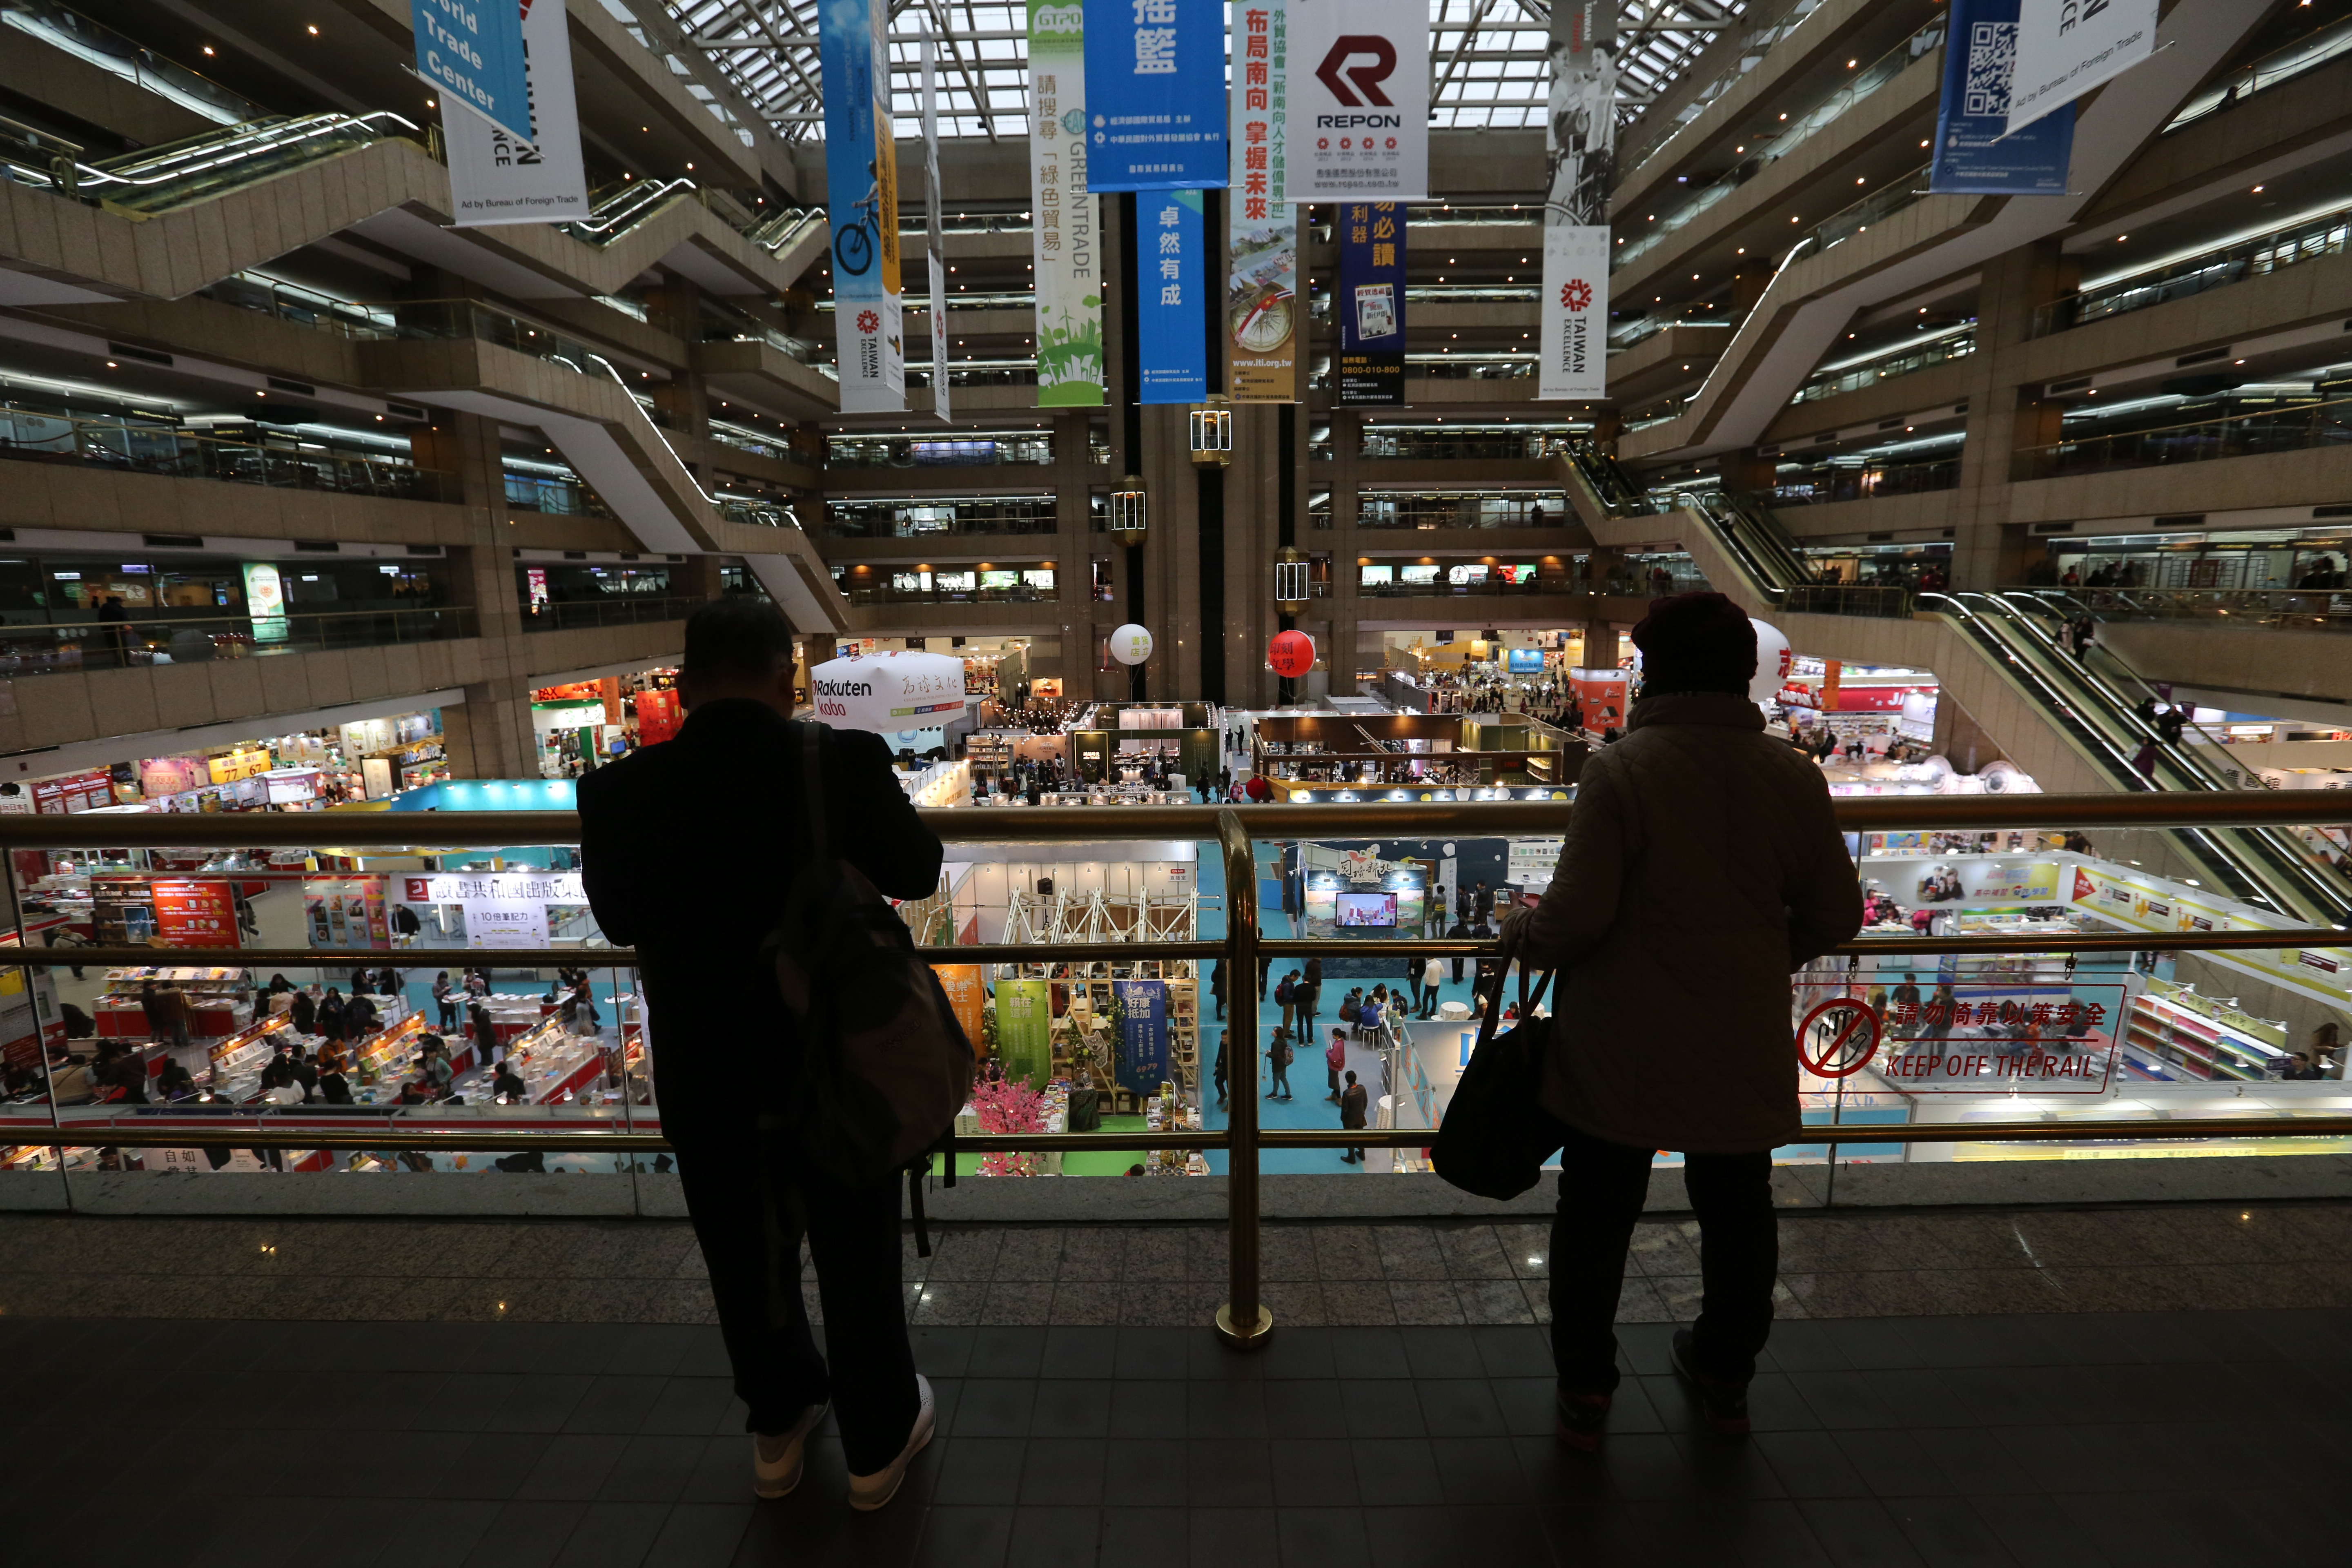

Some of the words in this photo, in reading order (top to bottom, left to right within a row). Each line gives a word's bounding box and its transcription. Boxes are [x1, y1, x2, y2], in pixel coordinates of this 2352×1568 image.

[430, 0, 478, 35] orld
[1584, 2, 1592, 41] TAIWAN
[422, 9, 483, 70] Trade
[1245, 8, 1268, 111] 布局南向
[2015, 96, 2027, 109] Ad
[2028, 90, 2038, 102] by
[2038, 74, 2069, 94] Bureau
[2070, 67, 2079, 78] of
[2080, 47, 2114, 71] Foreign
[2116, 29, 2143, 51] Trade
[427, 50, 495, 111] Center
[1317, 114, 1401, 129] REPON
[1037, 75, 1061, 262] 請搜尋「綠色貿易」
[1245, 120, 1267, 220] 掌握未來
[461, 200, 473, 209] Ad
[474, 199, 484, 210] by
[486, 198, 514, 207] Bureau
[526, 196, 555, 206] Foreign
[1351, 205, 1368, 243] 利器
[1159, 205, 1181, 305] 卓然有成
[1562, 318, 1572, 373] EXCELLENCE
[1573, 316, 1586, 373] TAIWAN
[868, 336, 879, 379] TAIWAN
[1232, 359, 1292, 369] www.iti.org.tw
[1342, 366, 1400, 374] 0800-010-800
[1131, 636, 1140, 657] 書店
[1270, 641, 1294, 655] 印刻
[1270, 658, 1295, 670] 文學
[817, 679, 872, 696] Rakuten
[902, 674, 958, 695] 高談文化
[817, 698, 846, 716] kobo
[223, 768, 237, 782] 77
[248, 763, 261, 775] 67
[945, 981, 968, 992] 愛樂
[948, 992, 969, 1003] 人士
[1009, 997, 1032, 1008] 賴在
[1127, 998, 1151, 1009] 好康
[1010, 1009, 1033, 1019] 這裡
[1127, 1008, 1151, 1019] 抵加
[1895, 1001, 2107, 1027] 請勿倚靠以策安全
[1147, 1062, 1158, 1071] 79
[1885, 1055, 1942, 1077] KEEP
[1946, 1055, 1989, 1077] OFF
[1995, 1055, 2036, 1077] THE
[2041, 1055, 2093, 1077] RAIL
